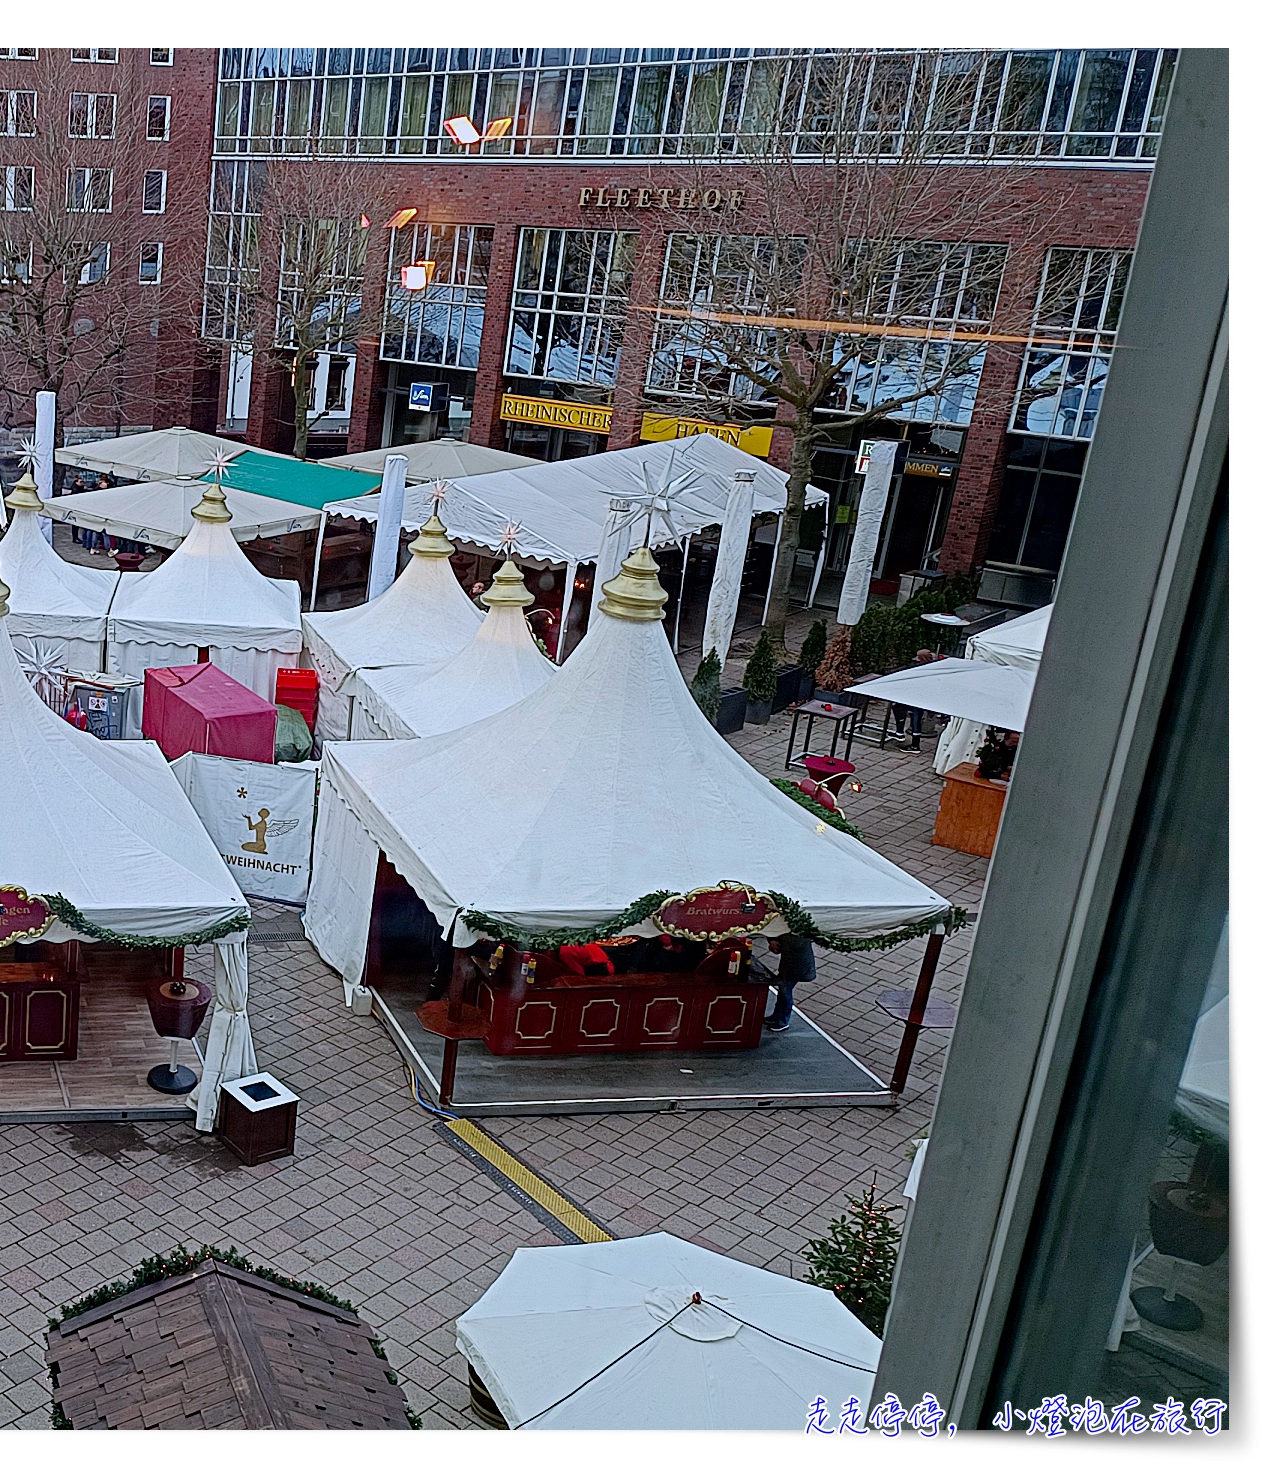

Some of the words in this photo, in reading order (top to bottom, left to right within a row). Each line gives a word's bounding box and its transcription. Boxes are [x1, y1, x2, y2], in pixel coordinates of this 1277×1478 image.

[579, 187, 745, 213] FLEETHOF
[503, 400, 612, 430] RHEINISCHER
[686, 906, 742, 916] Bratwurs
